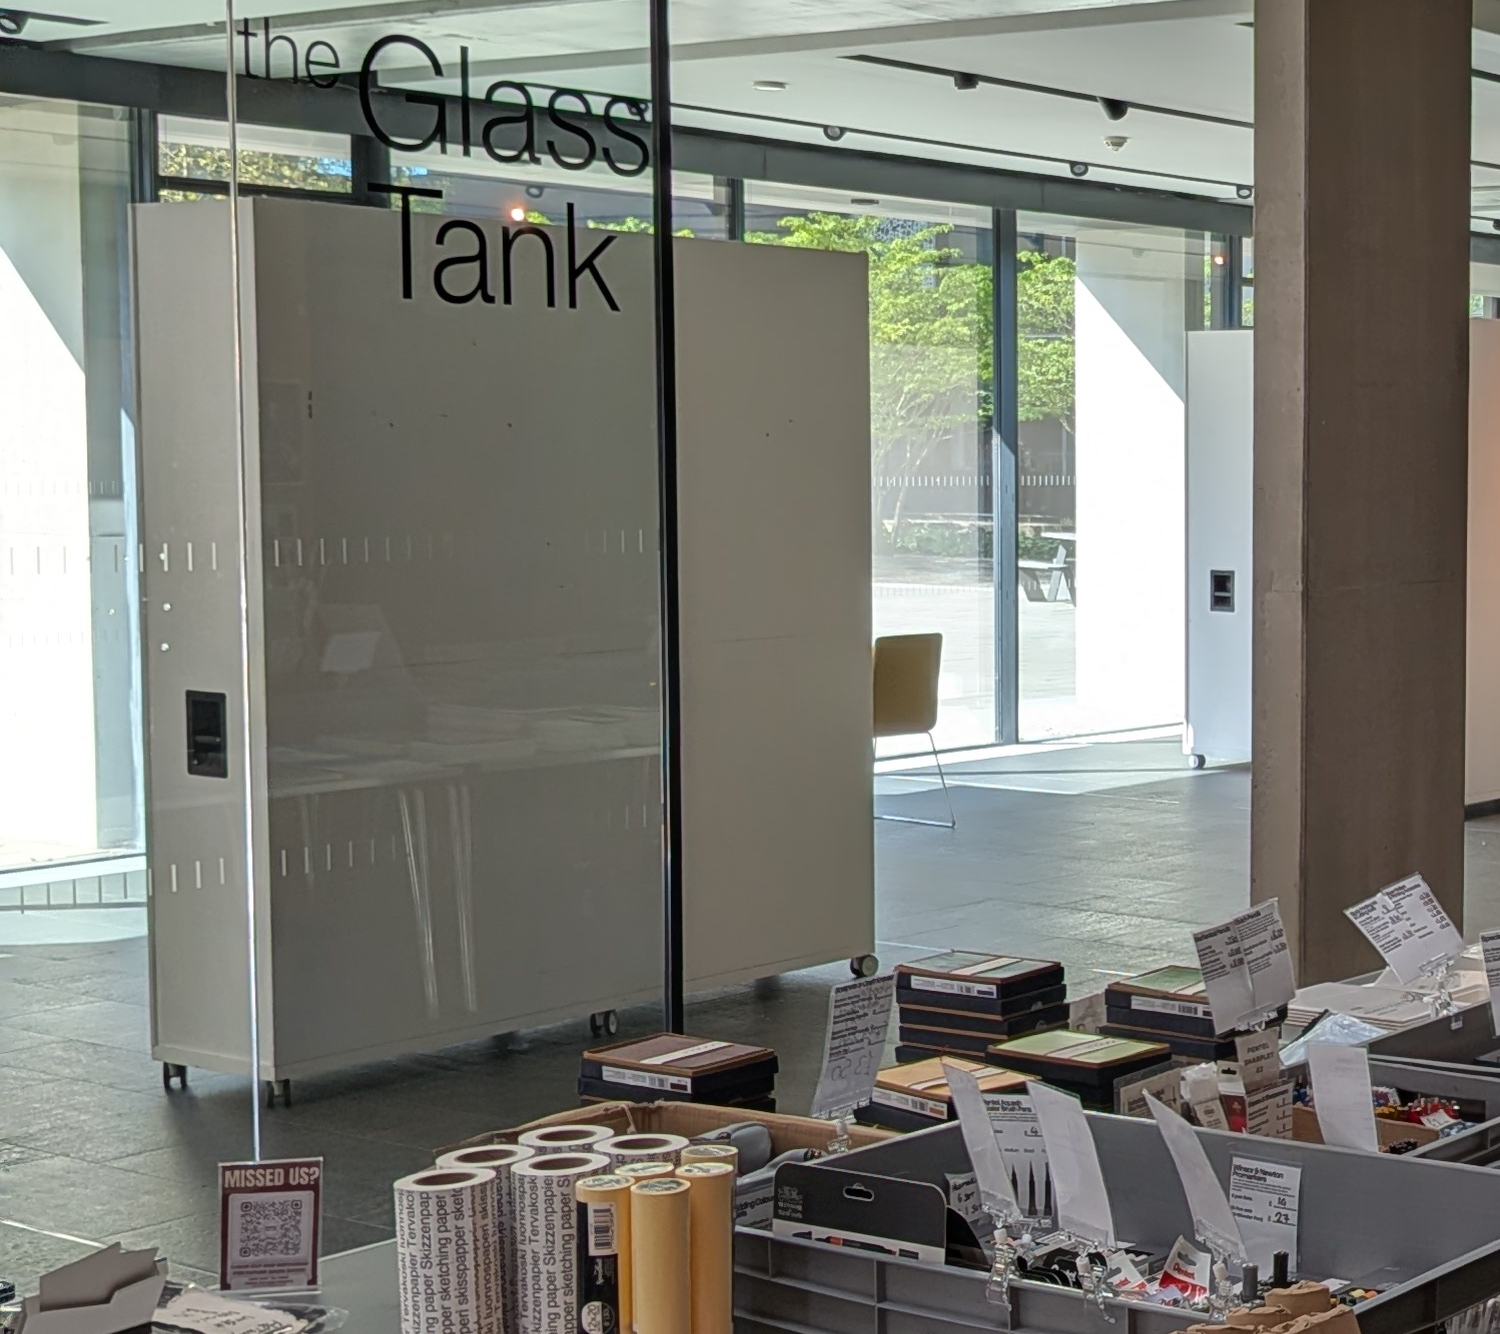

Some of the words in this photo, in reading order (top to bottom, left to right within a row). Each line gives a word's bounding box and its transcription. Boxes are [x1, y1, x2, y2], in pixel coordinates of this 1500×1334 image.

[235, 17, 341, 89] the
[358, 34, 651, 178] Glass
[368, 182, 621, 313] Tank
[224, 1168, 285, 1188] MISSED
[288, 1166, 319, 1185] US?
[435, 1195, 448, 1233] paper
[560, 1191, 574, 1229] paper
[436, 1237, 451, 1301] sketching
[452, 1225, 470, 1305] skisspapper
[546, 1269, 560, 1308] paper
[560, 1234, 574, 1297] sketching
[422, 1274, 436, 1313] paper
